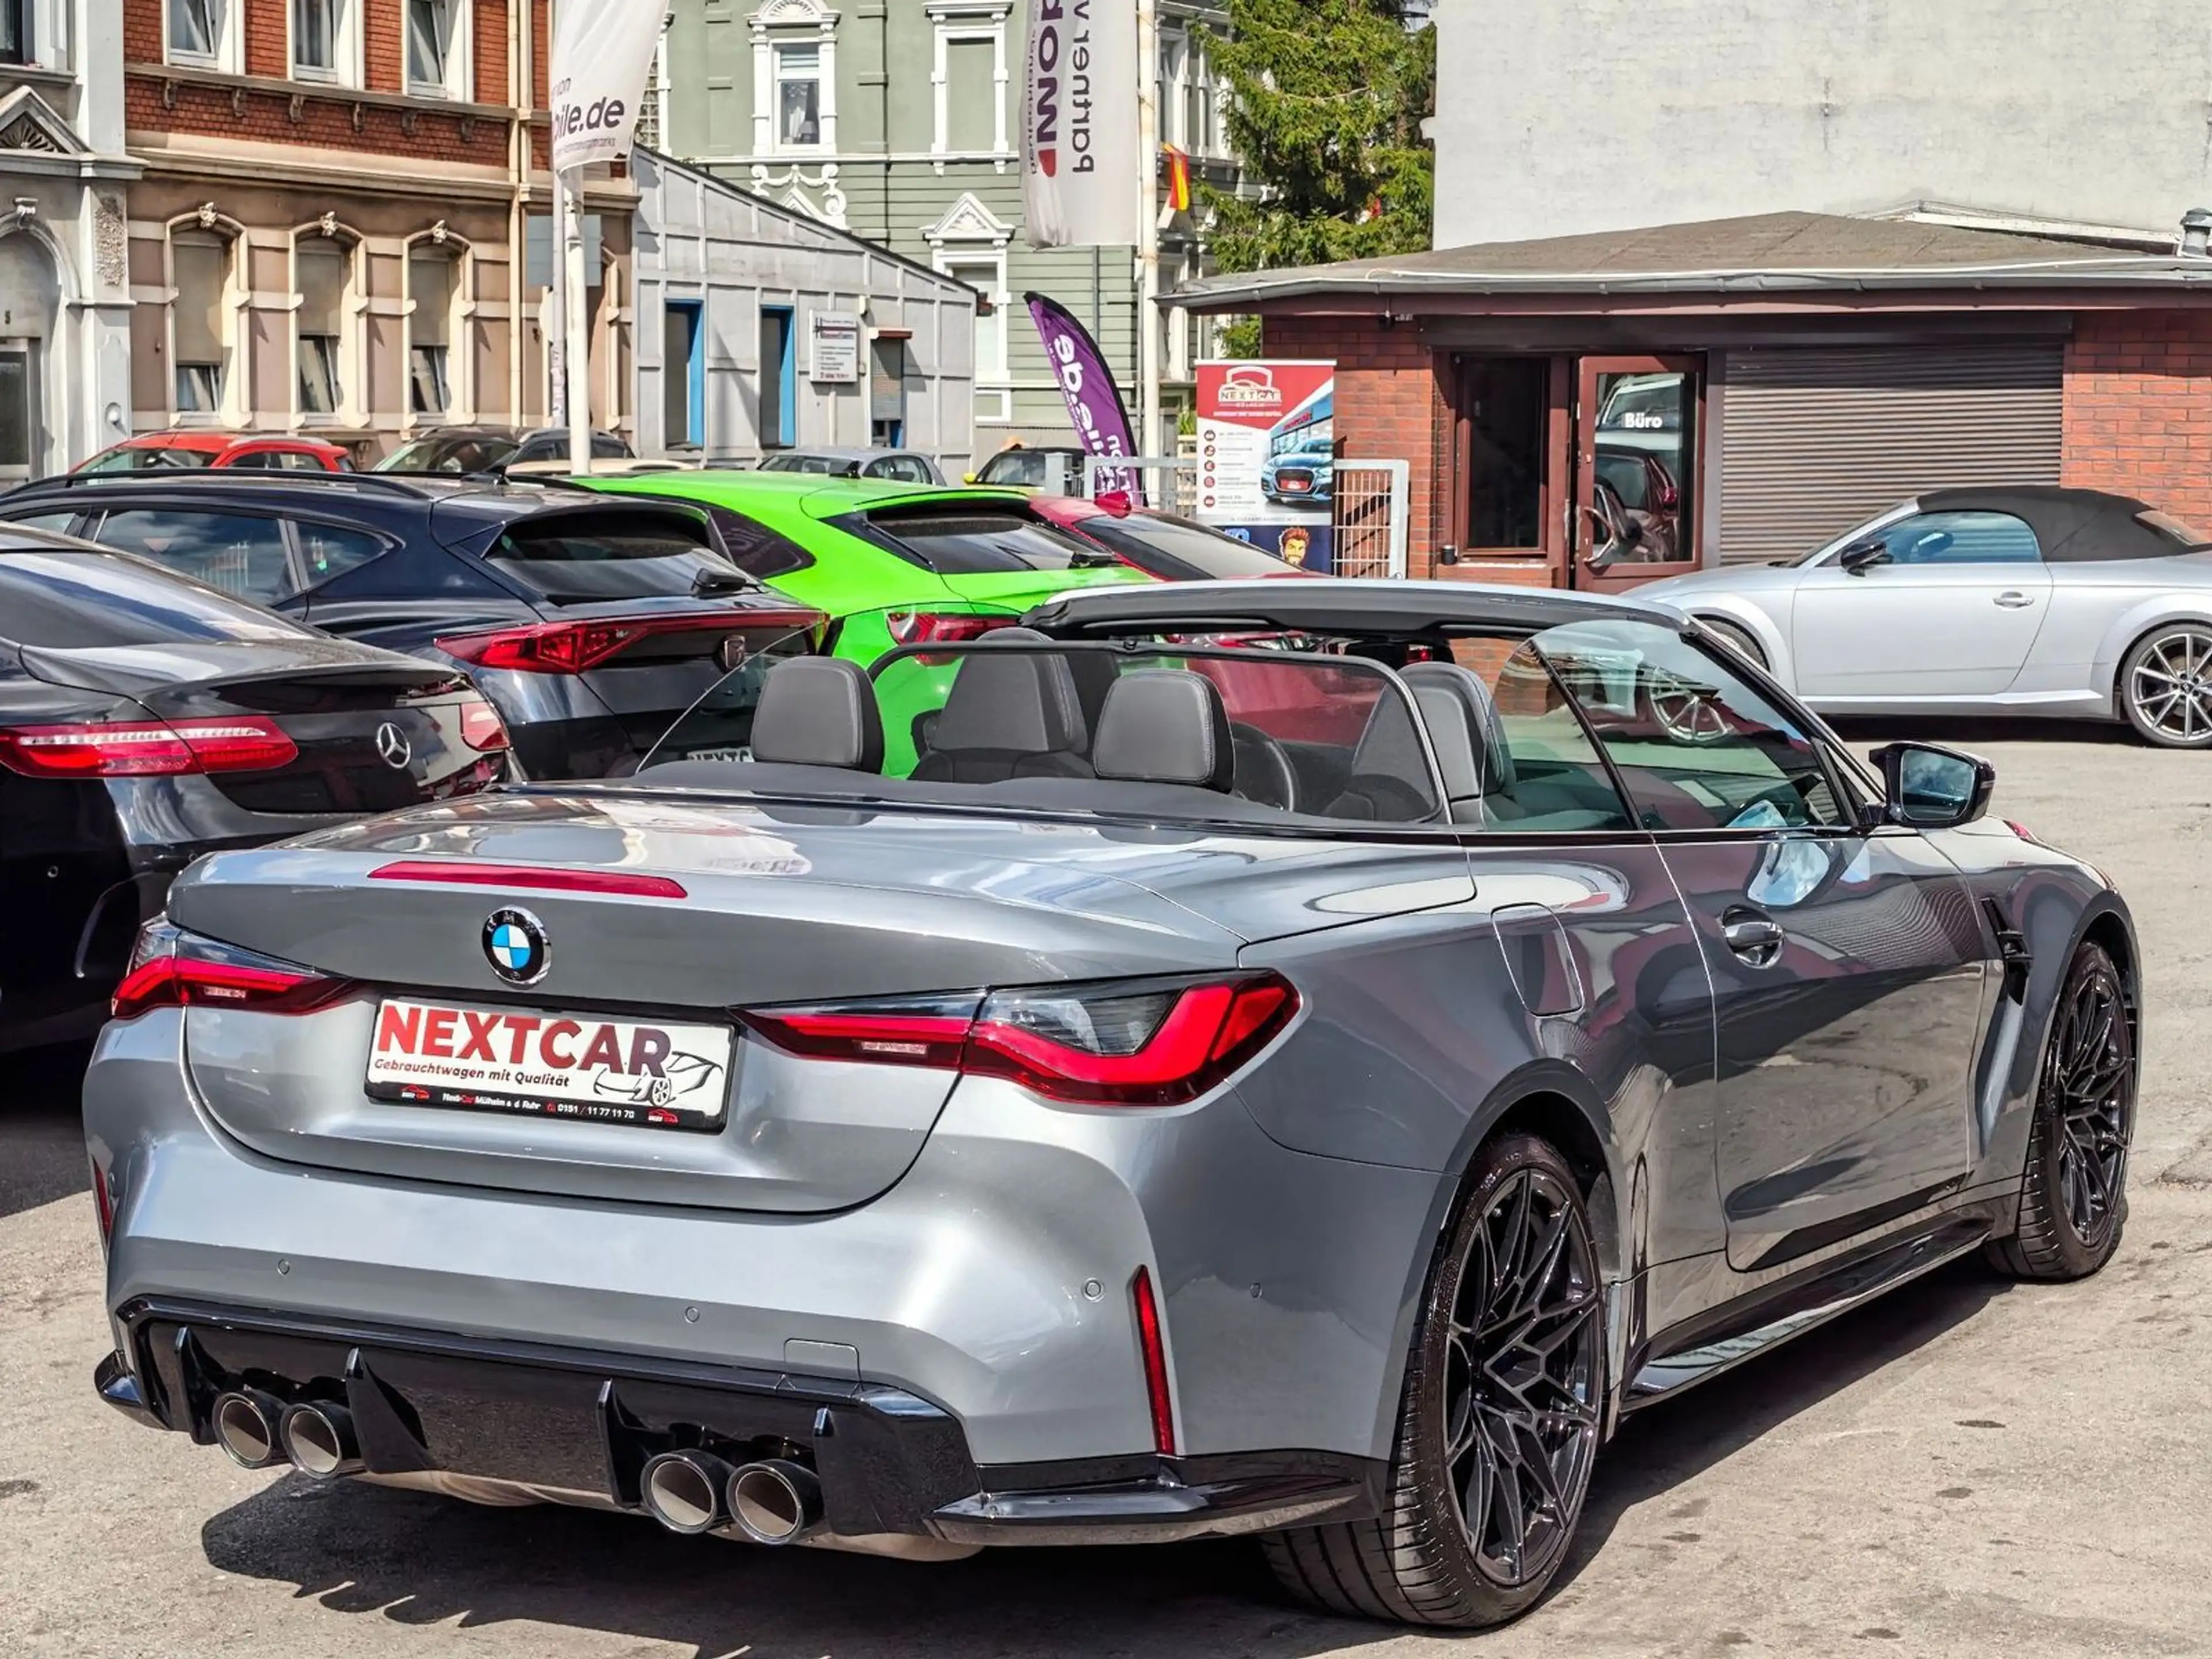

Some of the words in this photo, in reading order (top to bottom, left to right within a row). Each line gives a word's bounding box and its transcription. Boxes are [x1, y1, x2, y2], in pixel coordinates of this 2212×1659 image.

[1625, 412, 1662, 428] Büro
[377, 1005, 671, 1078] NEXTCAR
[374, 1059, 484, 1079] Gebrauchtwagen
[488, 1069, 511, 1081] mit
[514, 1072, 570, 1088] Qualität
[588, 1106, 597, 1115] 11
[600, 1107, 611, 1116] 77
[612, 1109, 622, 1118] 11
